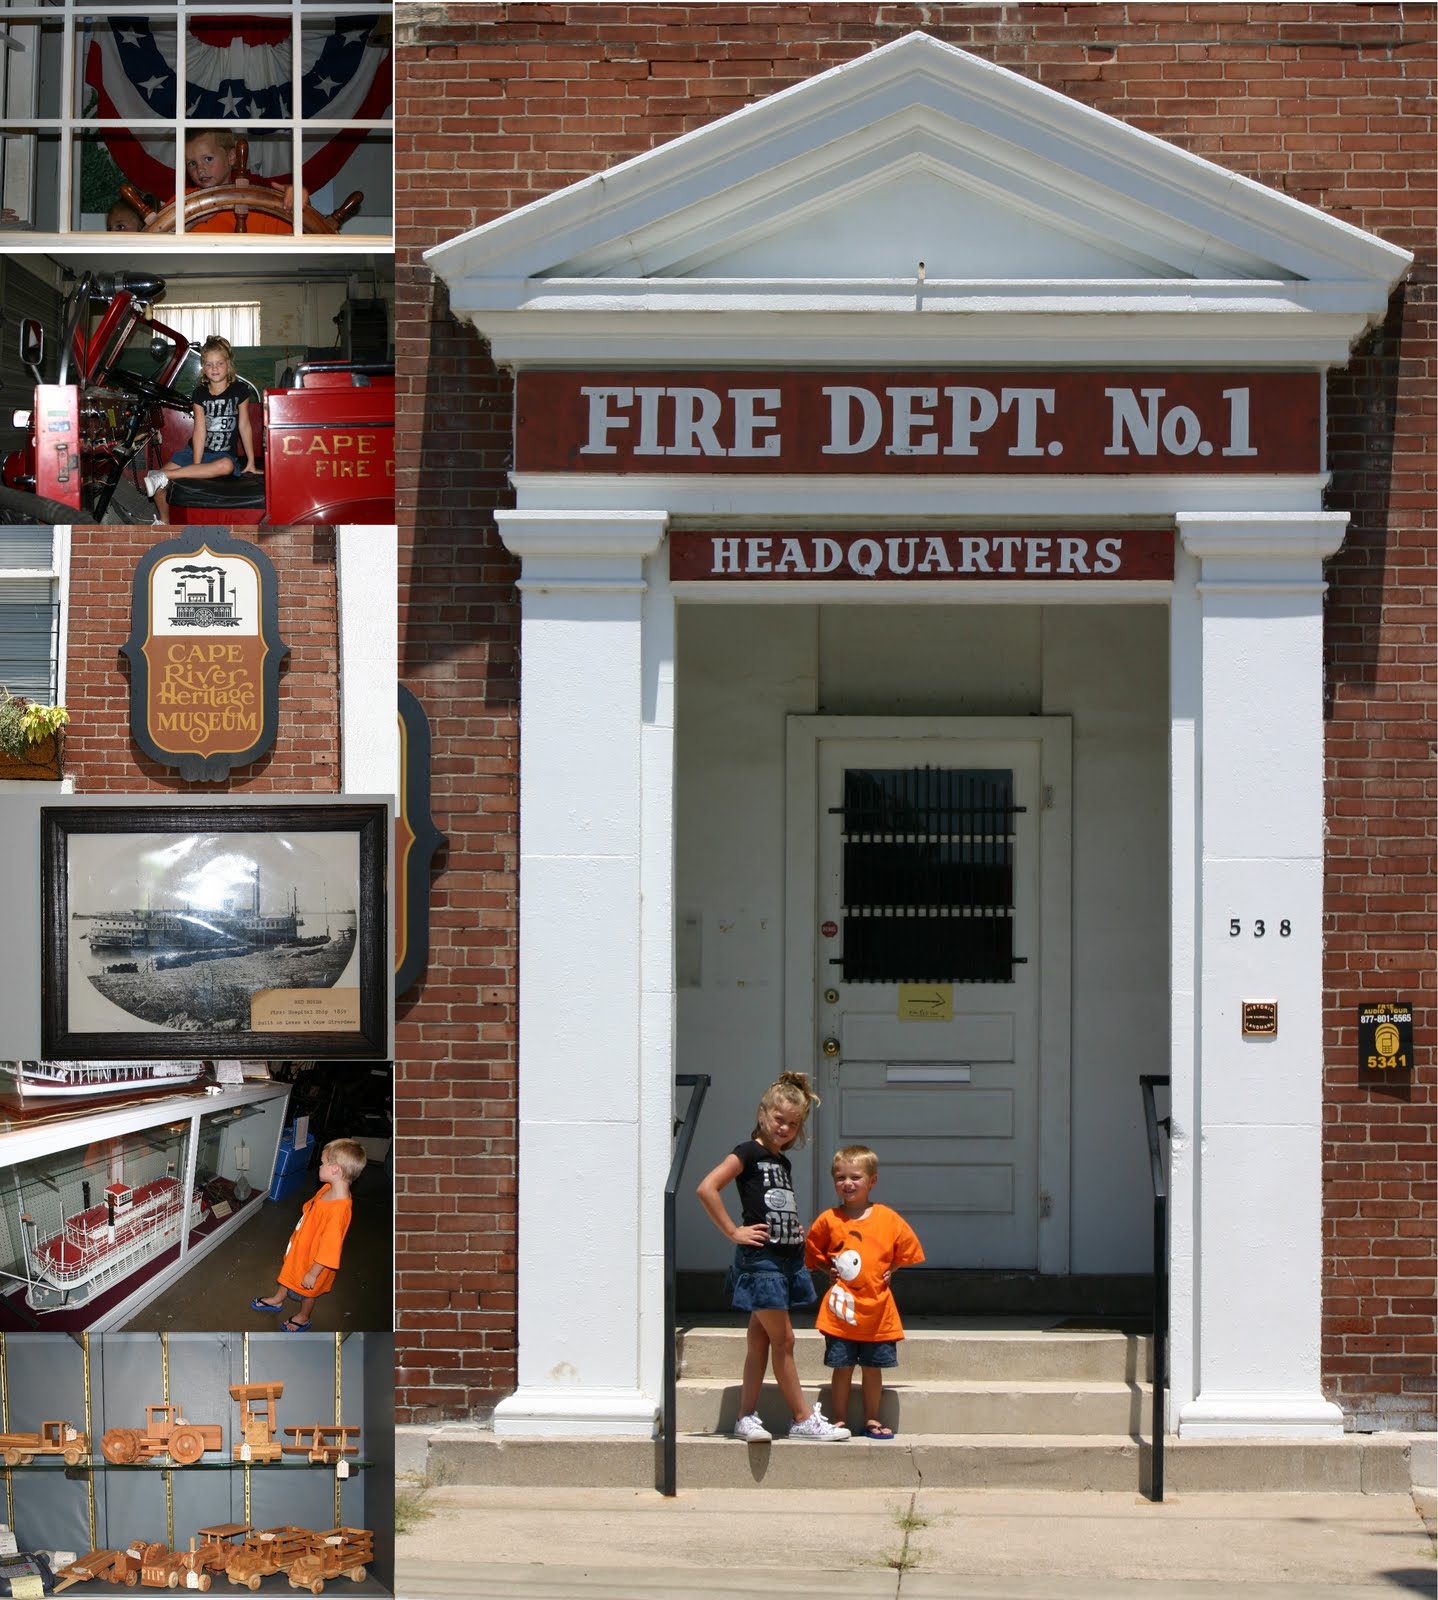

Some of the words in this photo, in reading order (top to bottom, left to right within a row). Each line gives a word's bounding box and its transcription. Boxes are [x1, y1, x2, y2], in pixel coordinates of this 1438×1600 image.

[221, 418, 233, 429] 97
[580, 386, 782, 457] FIRE
[822, 386, 1064, 457] DEPT.
[282, 435, 377, 455] CAPE
[316, 460, 371, 477] FIRE
[710, 537, 1123, 577] HEADQUARTERS
[167, 644, 244, 663] CAPE
[163, 663, 248, 692] River
[156, 681, 255, 717] Heritage
[156, 711, 257, 743] MUSEUM
[1360, 1014, 1412, 1023] 877-801-5565
[1367, 1054, 1407, 1068] 5341
